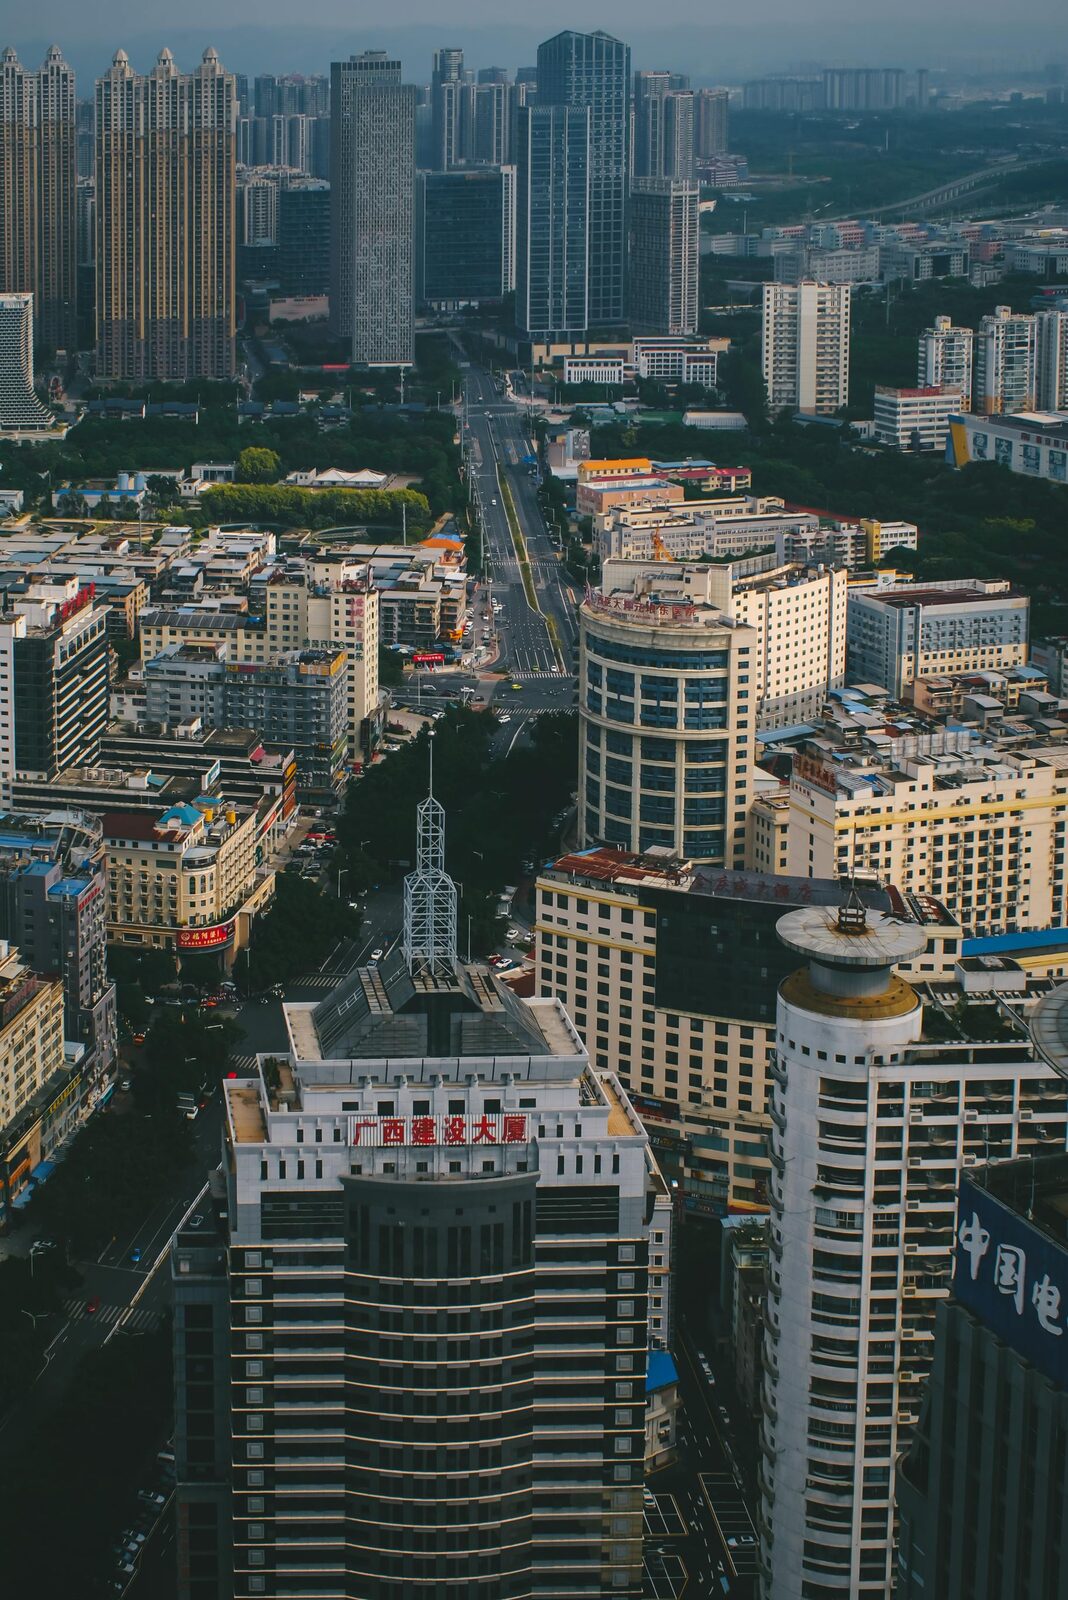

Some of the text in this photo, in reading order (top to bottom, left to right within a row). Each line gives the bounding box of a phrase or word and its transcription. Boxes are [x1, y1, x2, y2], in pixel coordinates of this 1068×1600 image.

[352, 1115, 527, 1145] 广西建设大厦
[958, 1211, 1063, 1336] 中国电
